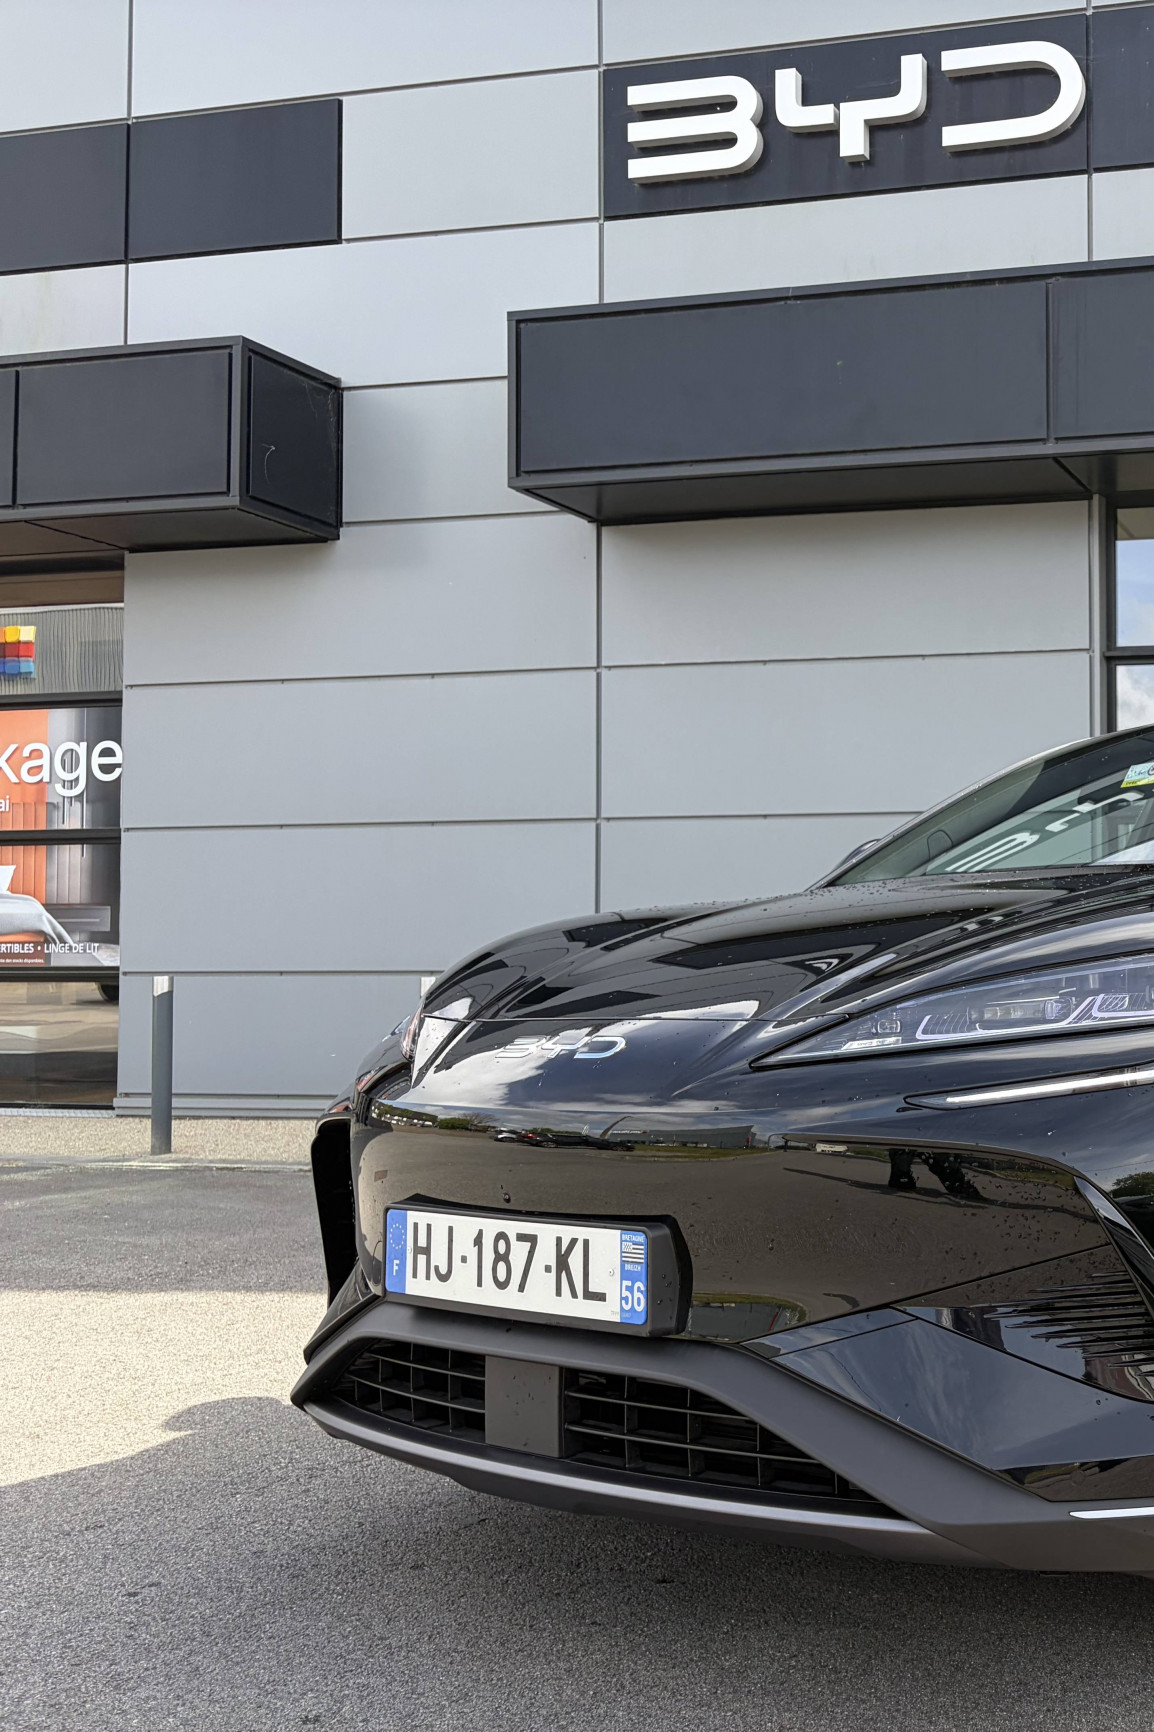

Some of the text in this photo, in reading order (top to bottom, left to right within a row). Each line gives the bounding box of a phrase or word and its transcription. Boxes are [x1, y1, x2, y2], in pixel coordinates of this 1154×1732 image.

[627, 40, 1086, 185] BYD
[44, 943, 70, 954] LINGE
[72, 943, 84, 953] DE
[86, 943, 99, 953] LIT
[495, 1034, 627, 1059] BYD
[621, 1233, 645, 1242] BRETAGNE
[393, 1260, 400, 1276] F
[624, 1263, 641, 1272] BREIZH
[621, 1279, 645, 1312] 56
